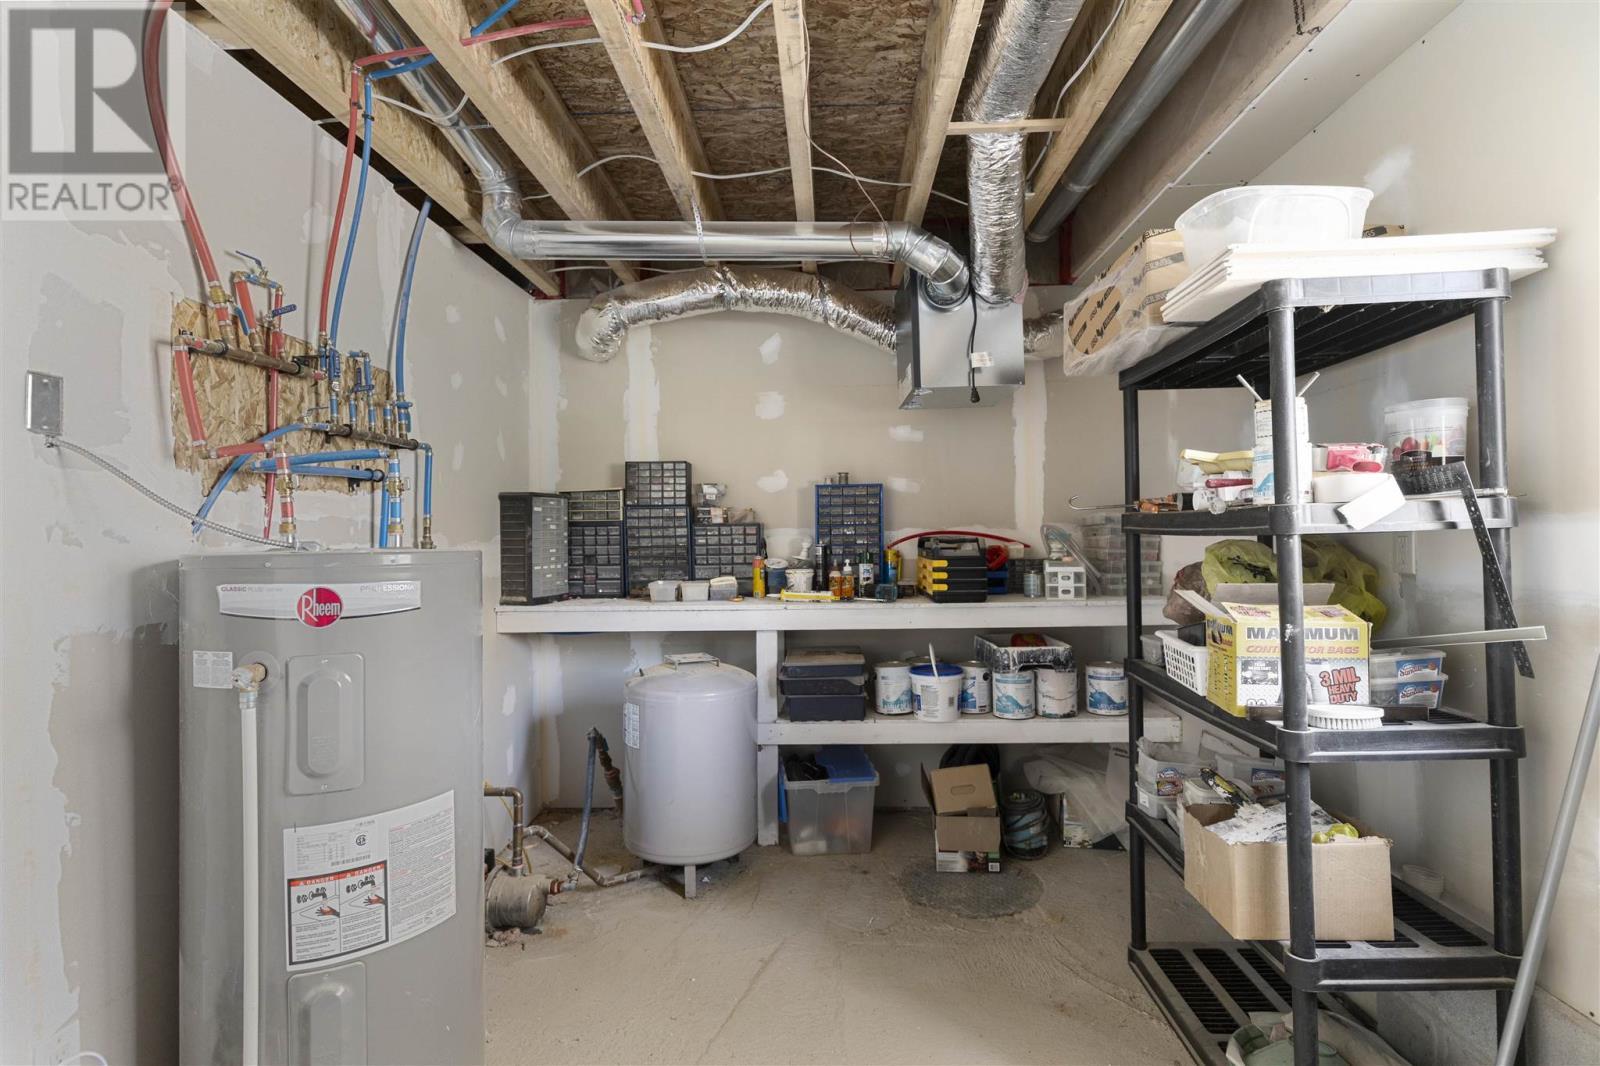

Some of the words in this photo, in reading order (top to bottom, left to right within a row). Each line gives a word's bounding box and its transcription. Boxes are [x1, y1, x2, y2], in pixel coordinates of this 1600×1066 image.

[301, 588, 341, 622] Rheem
[1246, 627, 1359, 640] MAMUM
[1246, 645, 1324, 655] CONTOR
[1327, 645, 1360, 655] BAGS
[1319, 671, 1331, 687] 3
[1331, 667, 1361, 685] MIL
[1328, 682, 1357, 695] HEAVY
[1329, 692, 1358, 704] DUTY
